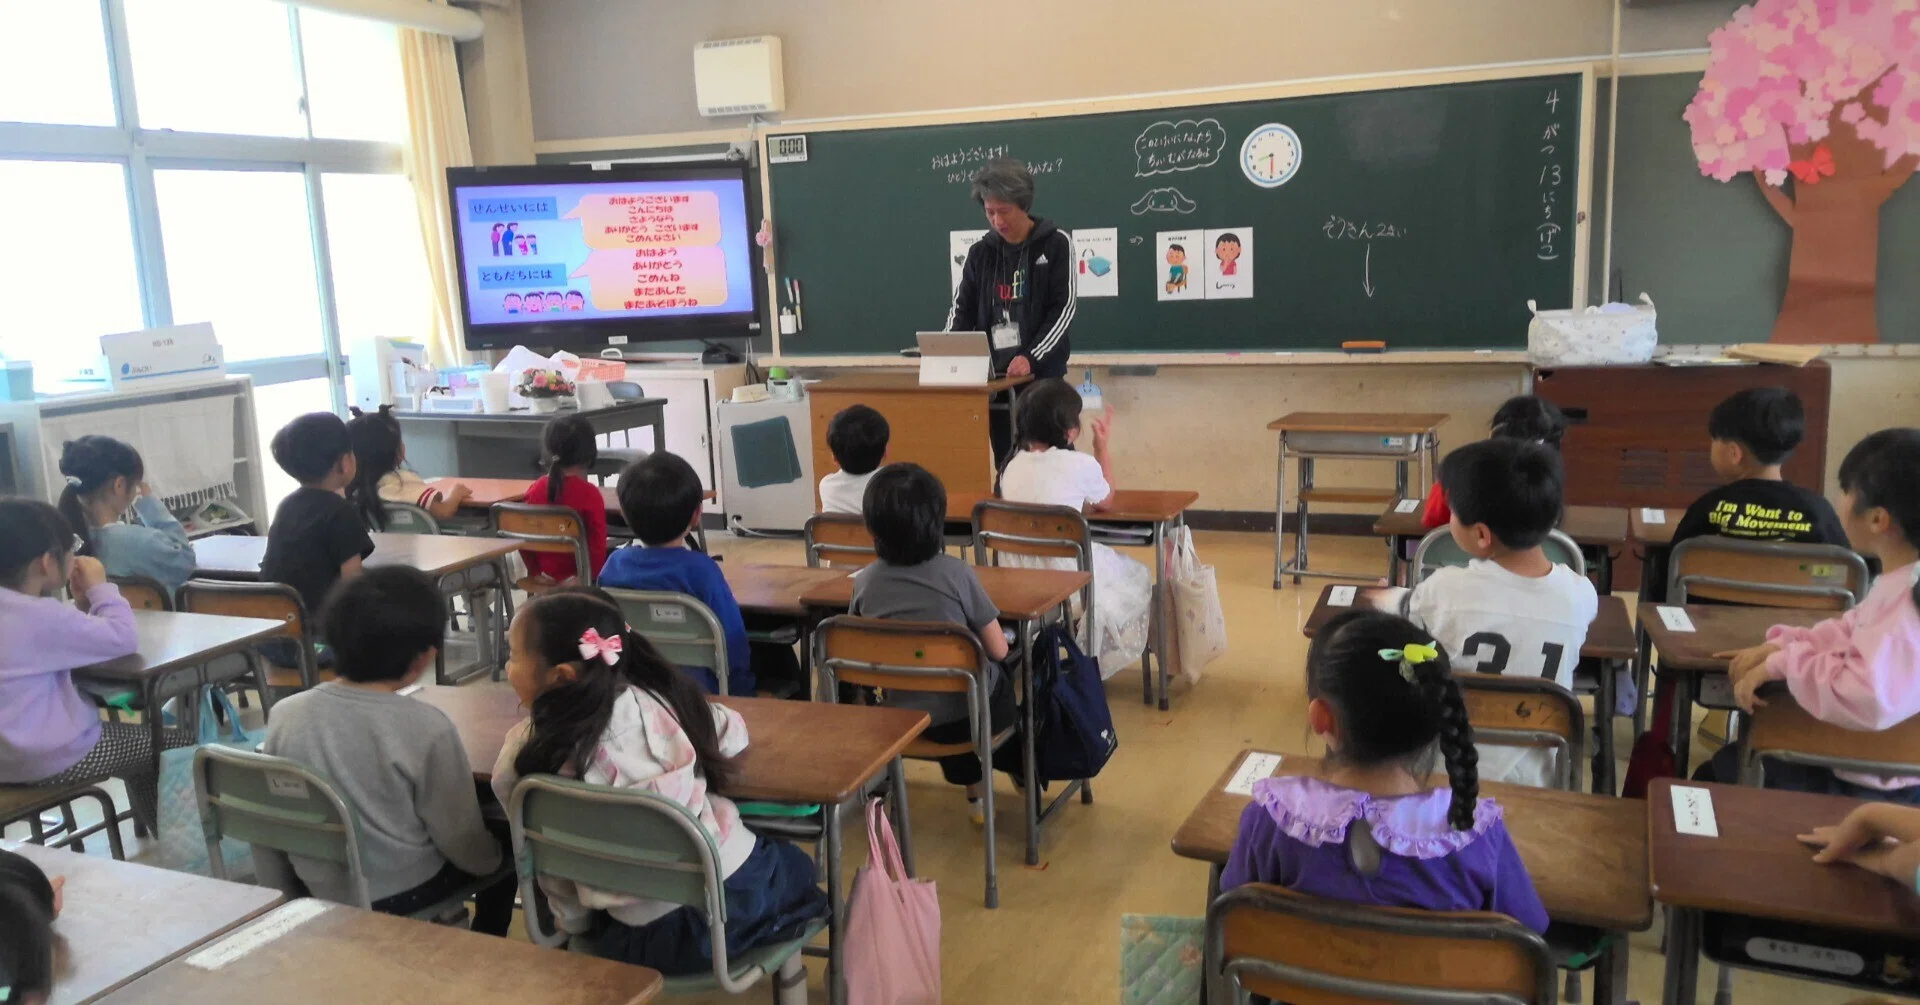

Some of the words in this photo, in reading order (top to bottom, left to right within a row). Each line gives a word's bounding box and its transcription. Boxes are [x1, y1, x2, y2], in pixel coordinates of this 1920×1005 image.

[473, 202, 548, 214] せんせいには
[628, 205, 673, 214] こんにちは
[629, 215, 674, 224] さようなら
[604, 225, 648, 234] ありがとう
[635, 247, 677, 258] おはよう
[632, 260, 683, 270] ありがとう
[482, 269, 552, 282] ともだちには
[633, 286, 686, 297] またあした
[623, 298, 698, 310] またあそぼうね
[1745, 503, 1781, 519] Want
[1788, 510, 1804, 522] to
[1735, 514, 1812, 532] Movement
